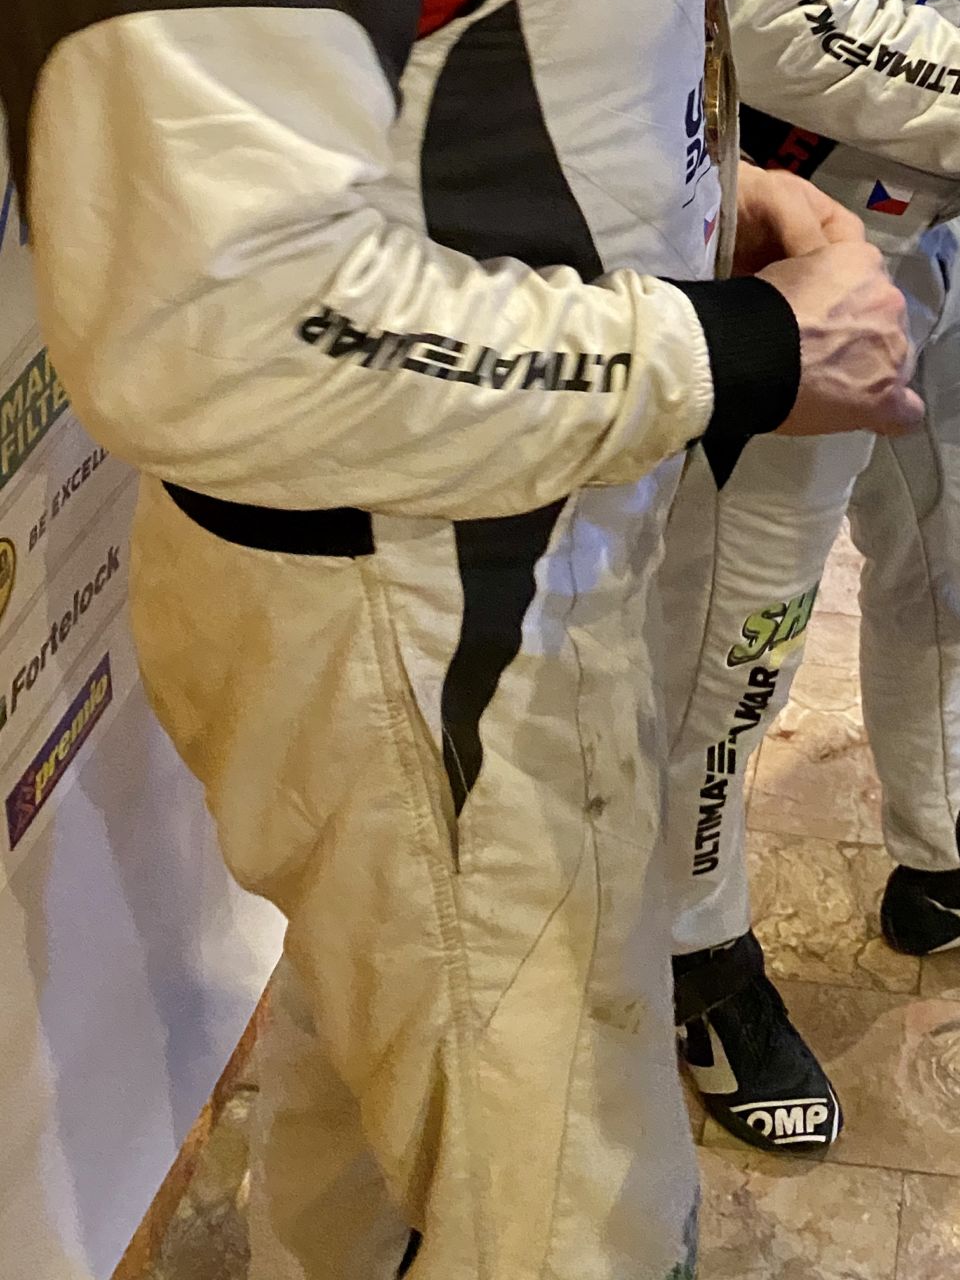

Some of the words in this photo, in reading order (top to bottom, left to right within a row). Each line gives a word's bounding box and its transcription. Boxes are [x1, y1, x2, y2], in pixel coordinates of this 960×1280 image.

[29, 508, 47, 553] BE
[10, 545, 120, 716] Fortelock
[34, 673, 108, 805] premio
[746, 1104, 829, 1138] OMP
